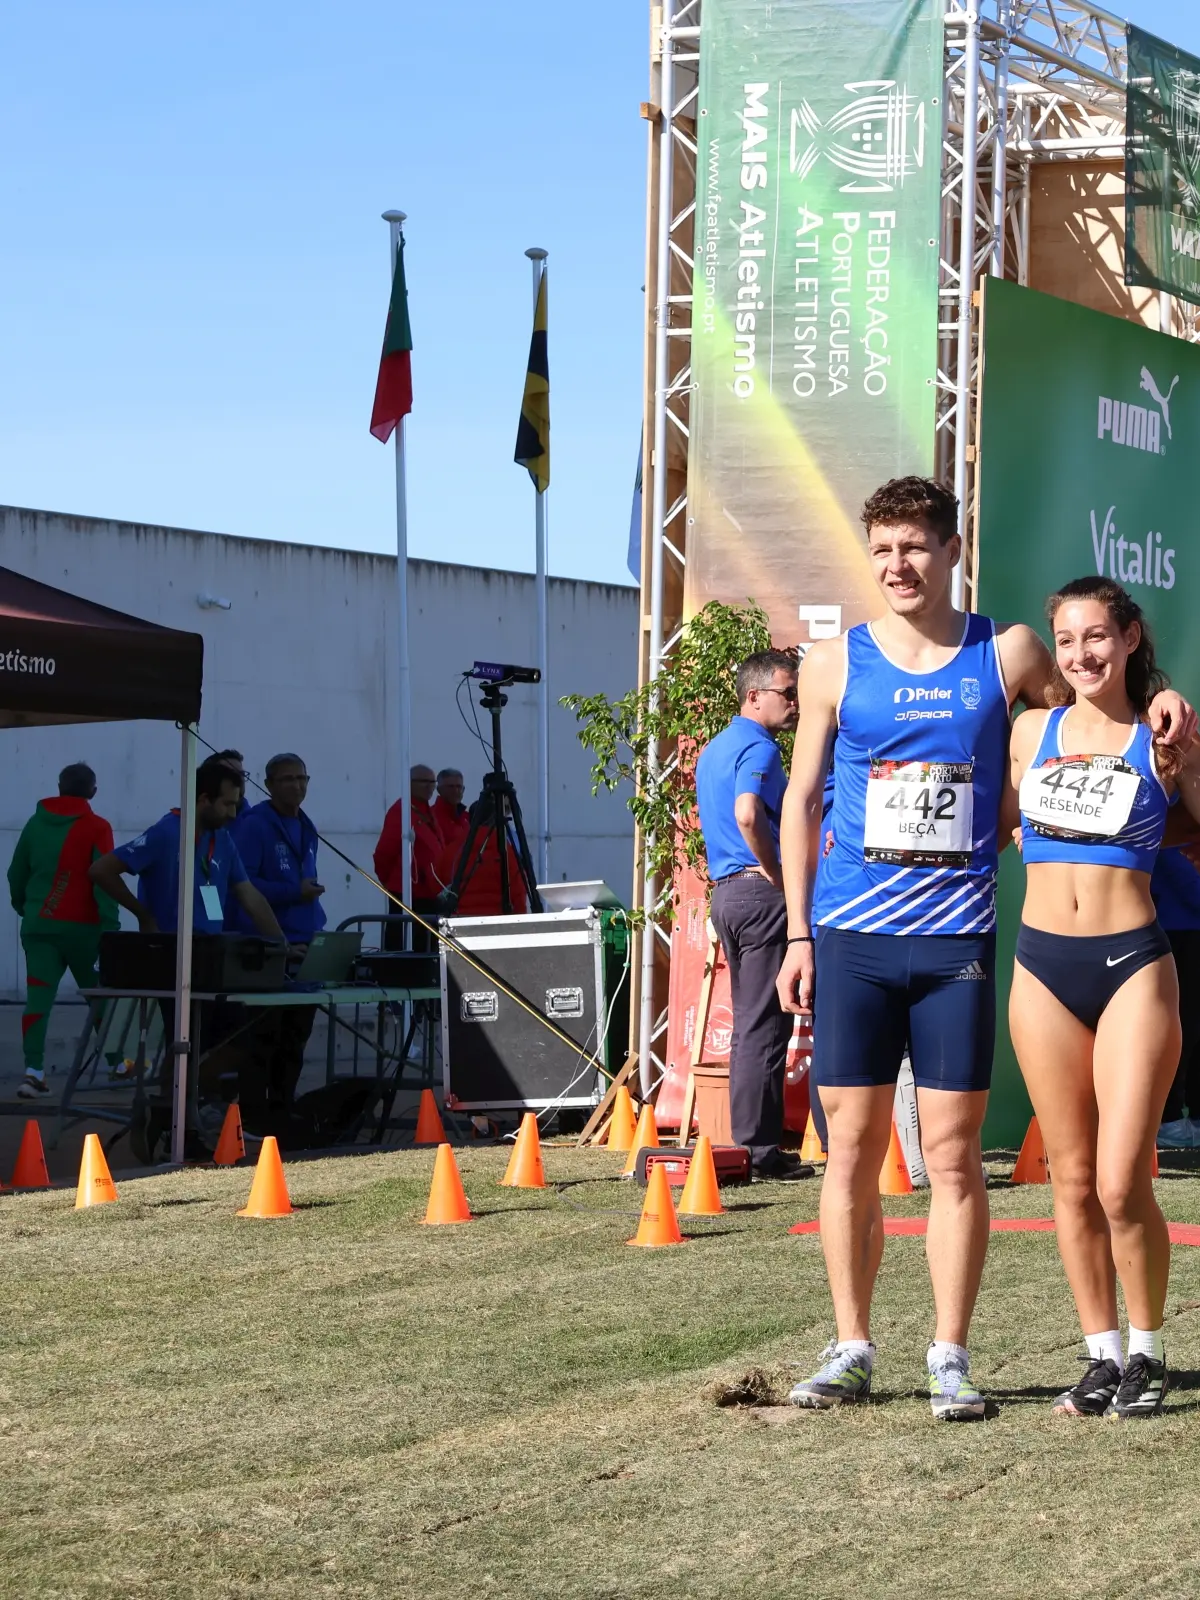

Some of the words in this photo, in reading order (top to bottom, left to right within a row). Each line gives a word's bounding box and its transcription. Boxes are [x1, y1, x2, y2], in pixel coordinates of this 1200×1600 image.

[740, 83, 769, 190] MAIS
[702, 138, 721, 334] www.fpatletismo.pt
[734, 202, 767, 399] Atletismo
[793, 205, 823, 397] ATLETISMO
[828, 212, 860, 397] PORTUGUESA
[861, 210, 896, 396] FEDERAÇÃO
[1097, 396, 1160, 454] PUMA
[1090, 505, 1176, 589] Vitalis
[916, 687, 953, 700] Prifer
[885, 787, 957, 820] 442
[1039, 796, 1104, 818] RESENDE
[1040, 767, 1114, 804] 444
[899, 822, 937, 838] BEÇA
